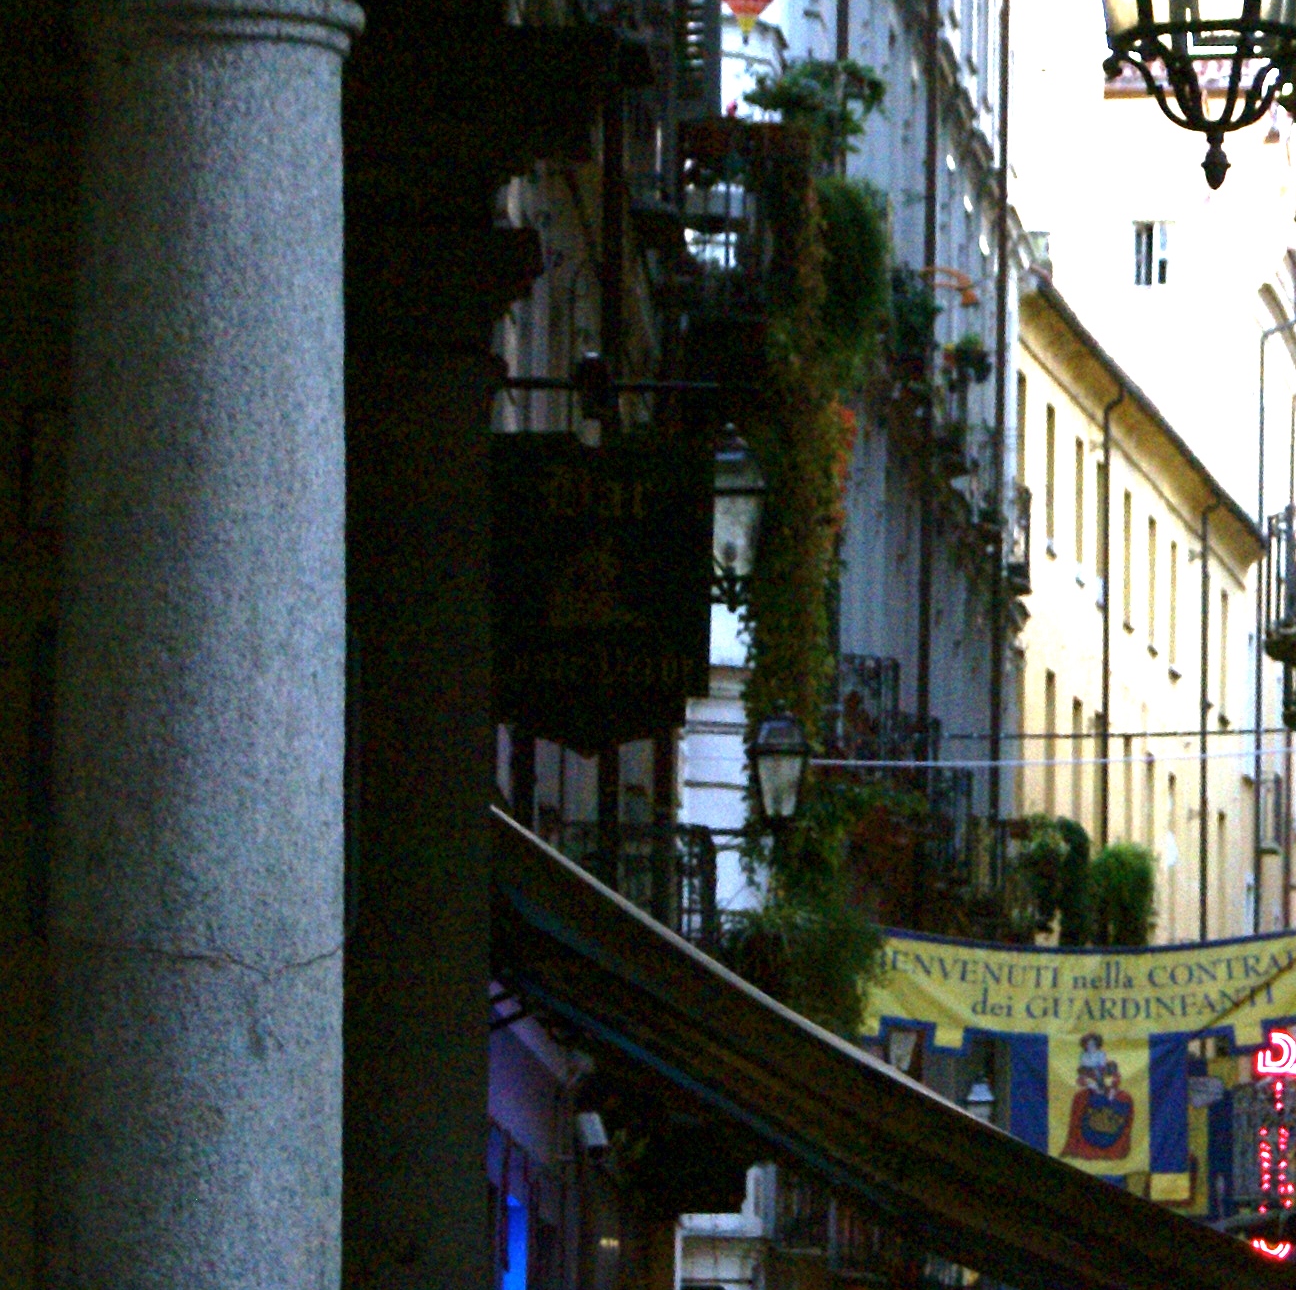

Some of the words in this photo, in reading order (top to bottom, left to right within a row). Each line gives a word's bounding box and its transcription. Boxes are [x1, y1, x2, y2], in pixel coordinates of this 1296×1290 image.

[1072, 961, 1134, 990] nella
[971, 986, 1013, 1018] dei
[1025, 982, 1274, 1020] GUARDINFANTI
